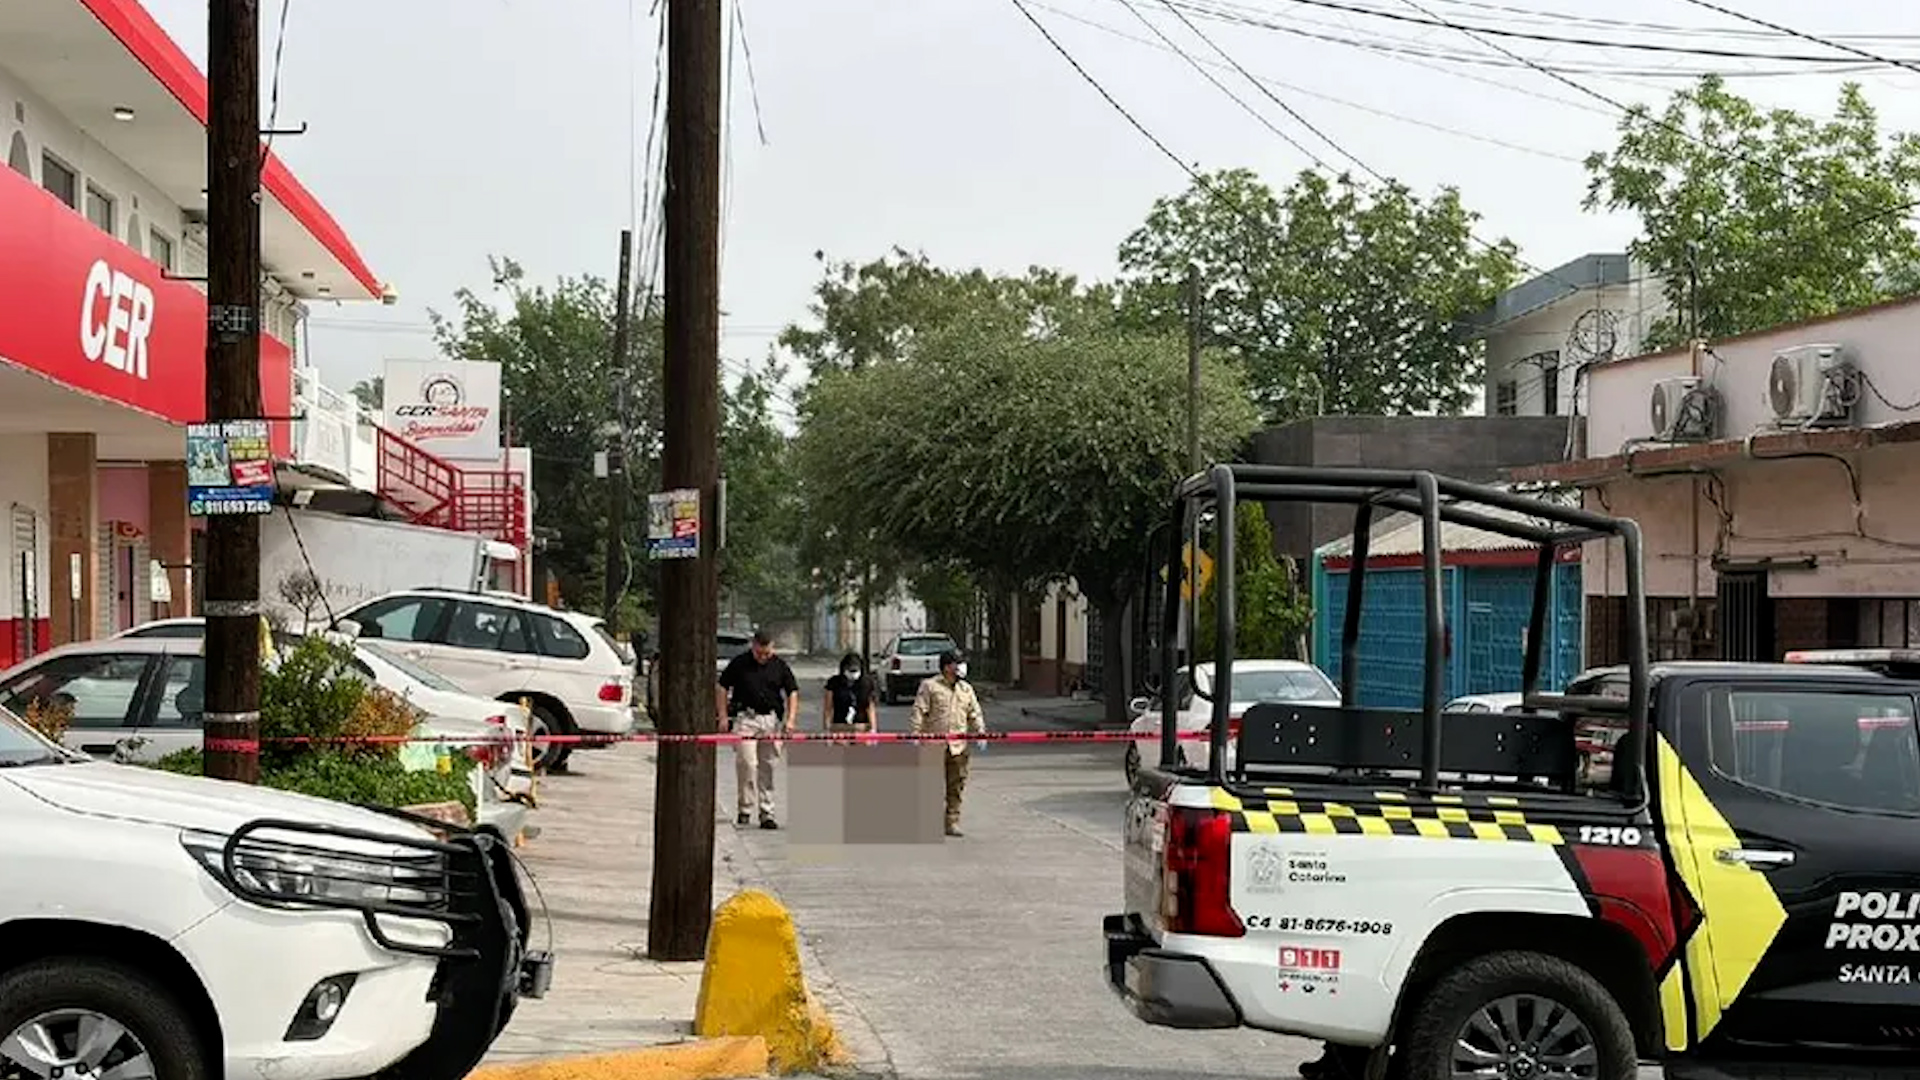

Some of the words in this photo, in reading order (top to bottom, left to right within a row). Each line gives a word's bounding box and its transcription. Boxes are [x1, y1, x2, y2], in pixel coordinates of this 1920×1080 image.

[81, 259, 155, 380] CER
[1579, 825, 1641, 845] 1210
[1289, 860, 1326, 869] Santa
[1834, 891, 1920, 919] POLI
[1247, 915, 1271, 928] C4
[1280, 917, 1393, 935] 81-8676-1908
[1283, 950, 1335, 968] 911
[1838, 963, 1910, 984] SANTA
